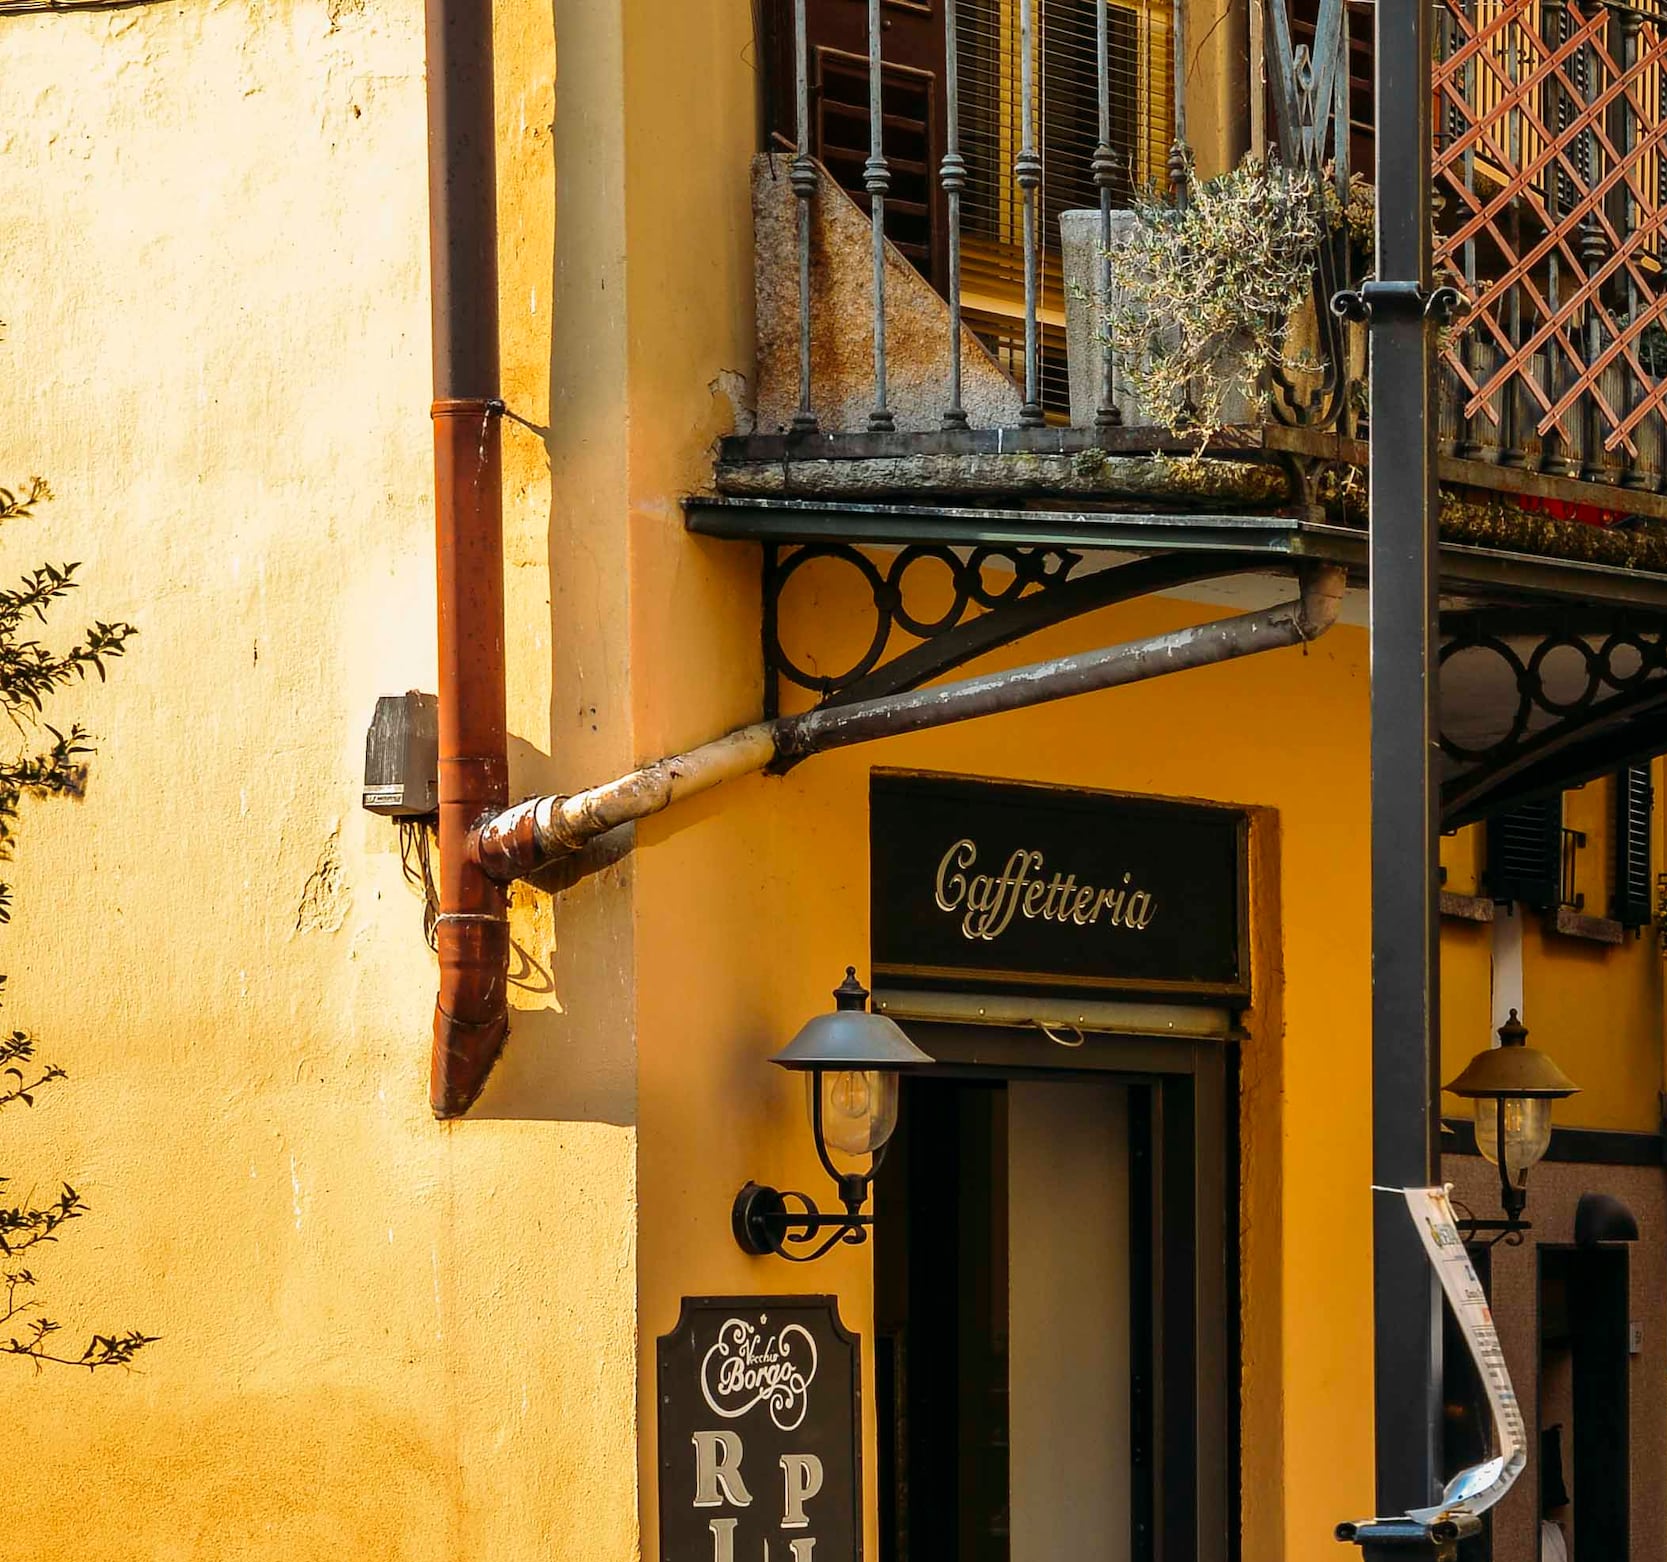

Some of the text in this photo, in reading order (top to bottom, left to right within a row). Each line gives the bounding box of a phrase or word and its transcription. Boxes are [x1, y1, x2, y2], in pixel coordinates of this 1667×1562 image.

[934, 838, 1158, 940] Caffetteria
[739, 1334, 780, 1365] Vecchio
[718, 1356, 797, 1400] Borgo
